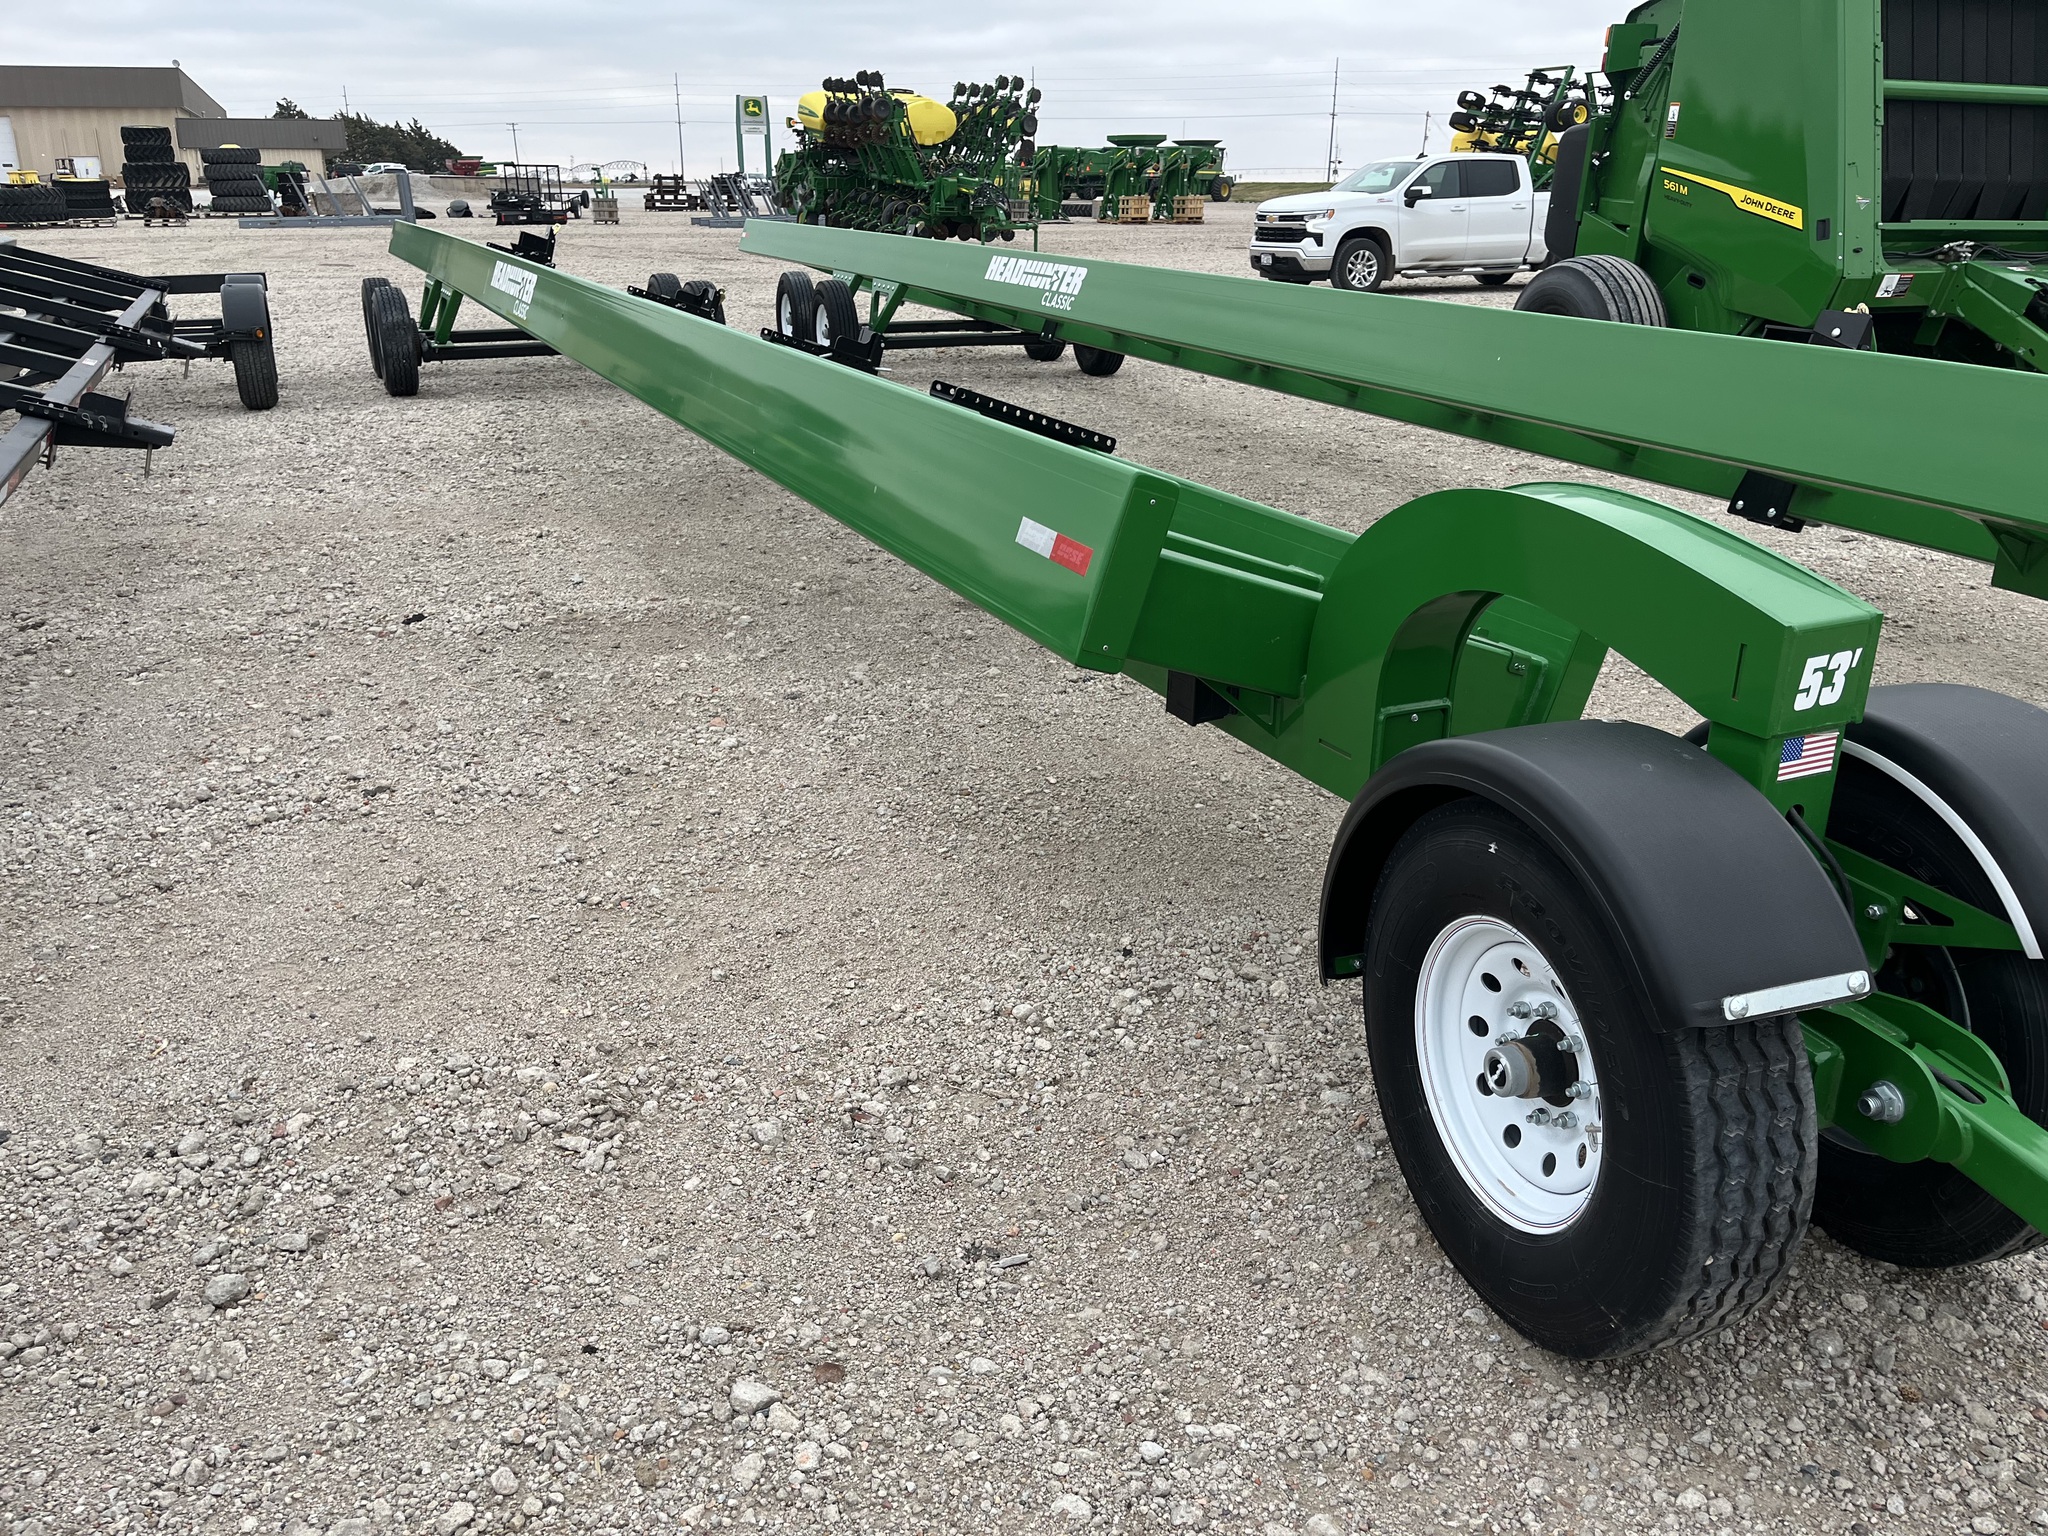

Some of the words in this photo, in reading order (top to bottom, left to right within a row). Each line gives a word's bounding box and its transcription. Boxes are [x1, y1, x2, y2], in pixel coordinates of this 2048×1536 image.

[1740, 195, 1764, 209] JOHN
[1765, 202, 1795, 219] DEERE
[984, 255, 1088, 296] HEADHUNTER
[1041, 292, 1075, 311] CLASSIC
